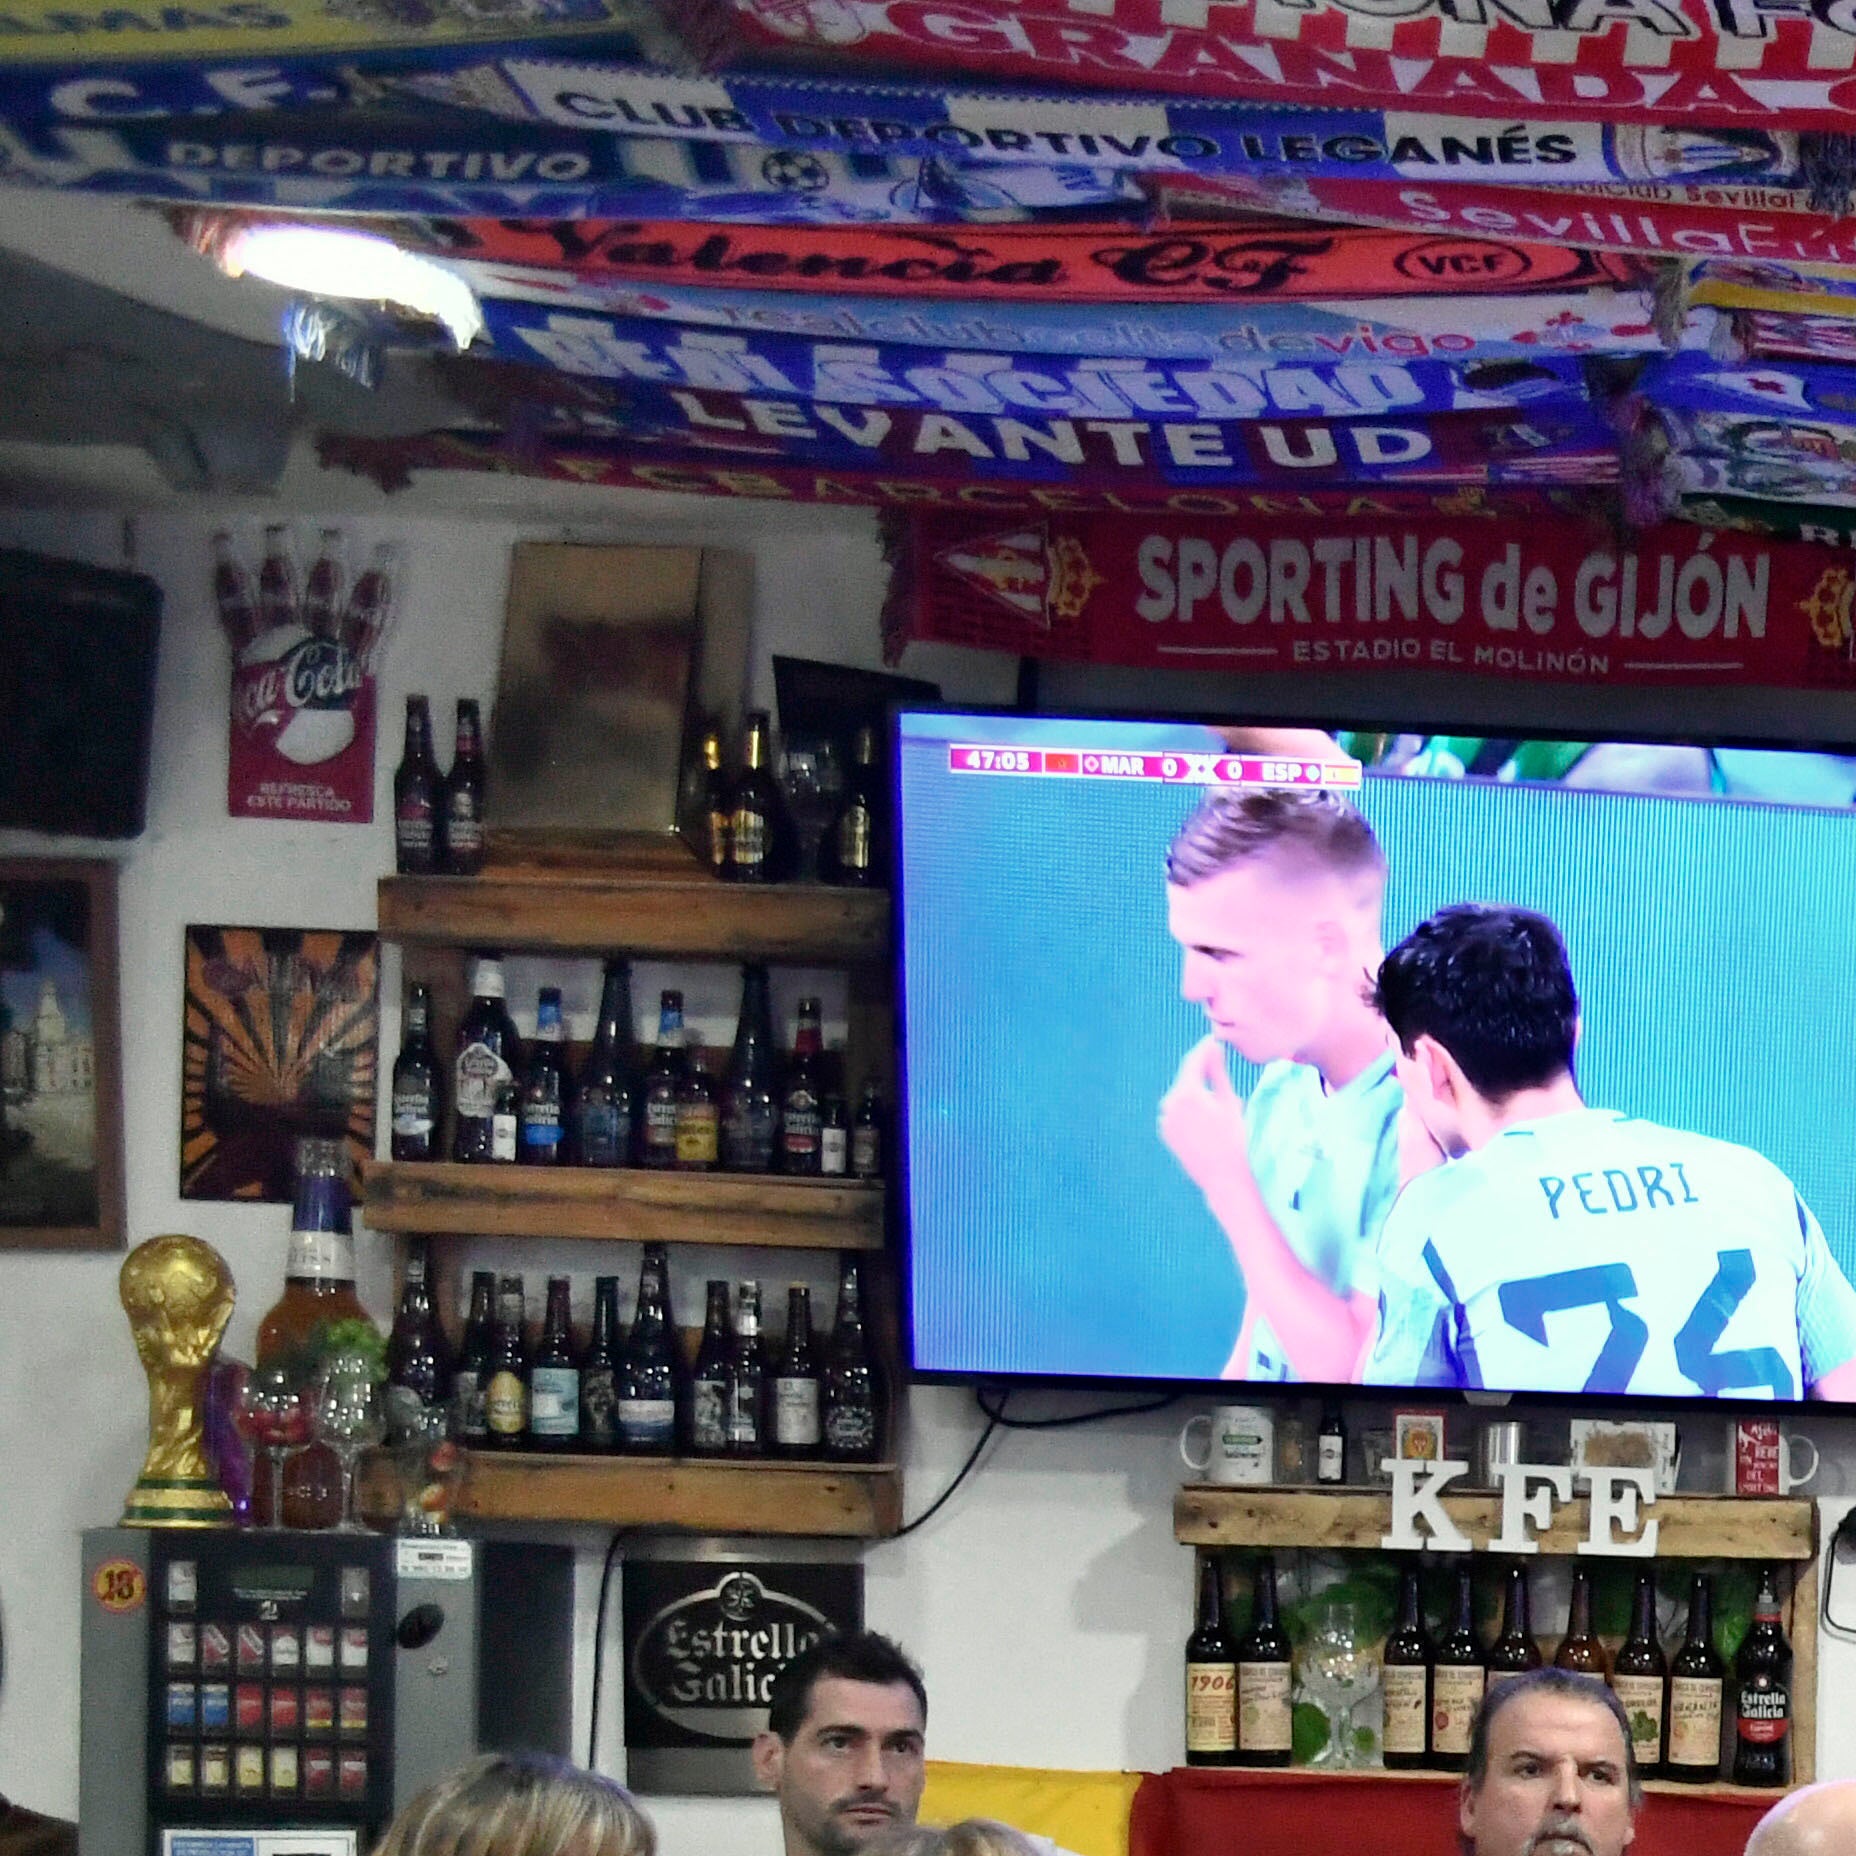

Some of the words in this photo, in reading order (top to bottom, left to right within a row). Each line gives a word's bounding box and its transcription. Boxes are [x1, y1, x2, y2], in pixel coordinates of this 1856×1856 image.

[886, 2, 1796, 115] GRANADA
[555, 90, 755, 132] CLUB
[775, 112, 1218, 160] DEPORTIVO
[1243, 123, 1577, 166] LEGANÉS
[167, 142, 591, 181] DEPORTIVO
[548, 220, 1070, 287] Valencia
[670, 391, 1234, 468] LEVANTE
[1260, 424, 1433, 470] UD
[1137, 535, 1468, 638] SPORTING
[1487, 550, 1560, 638] de
[1570, 523, 1770, 644] GIJÓN
[1293, 639, 1422, 665] ESTADIO
[1433, 644, 1472, 668] EL
[1479, 642, 1612, 678] MOLINÓN
[966, 751, 1031, 772] 47:05
[1100, 755, 1145, 777] MAR
[1162, 756, 1179, 778] 0
[1226, 761, 1243, 781] 0
[1262, 764, 1303, 787] ESP
[1540, 1160, 1701, 1220] PEDRI
